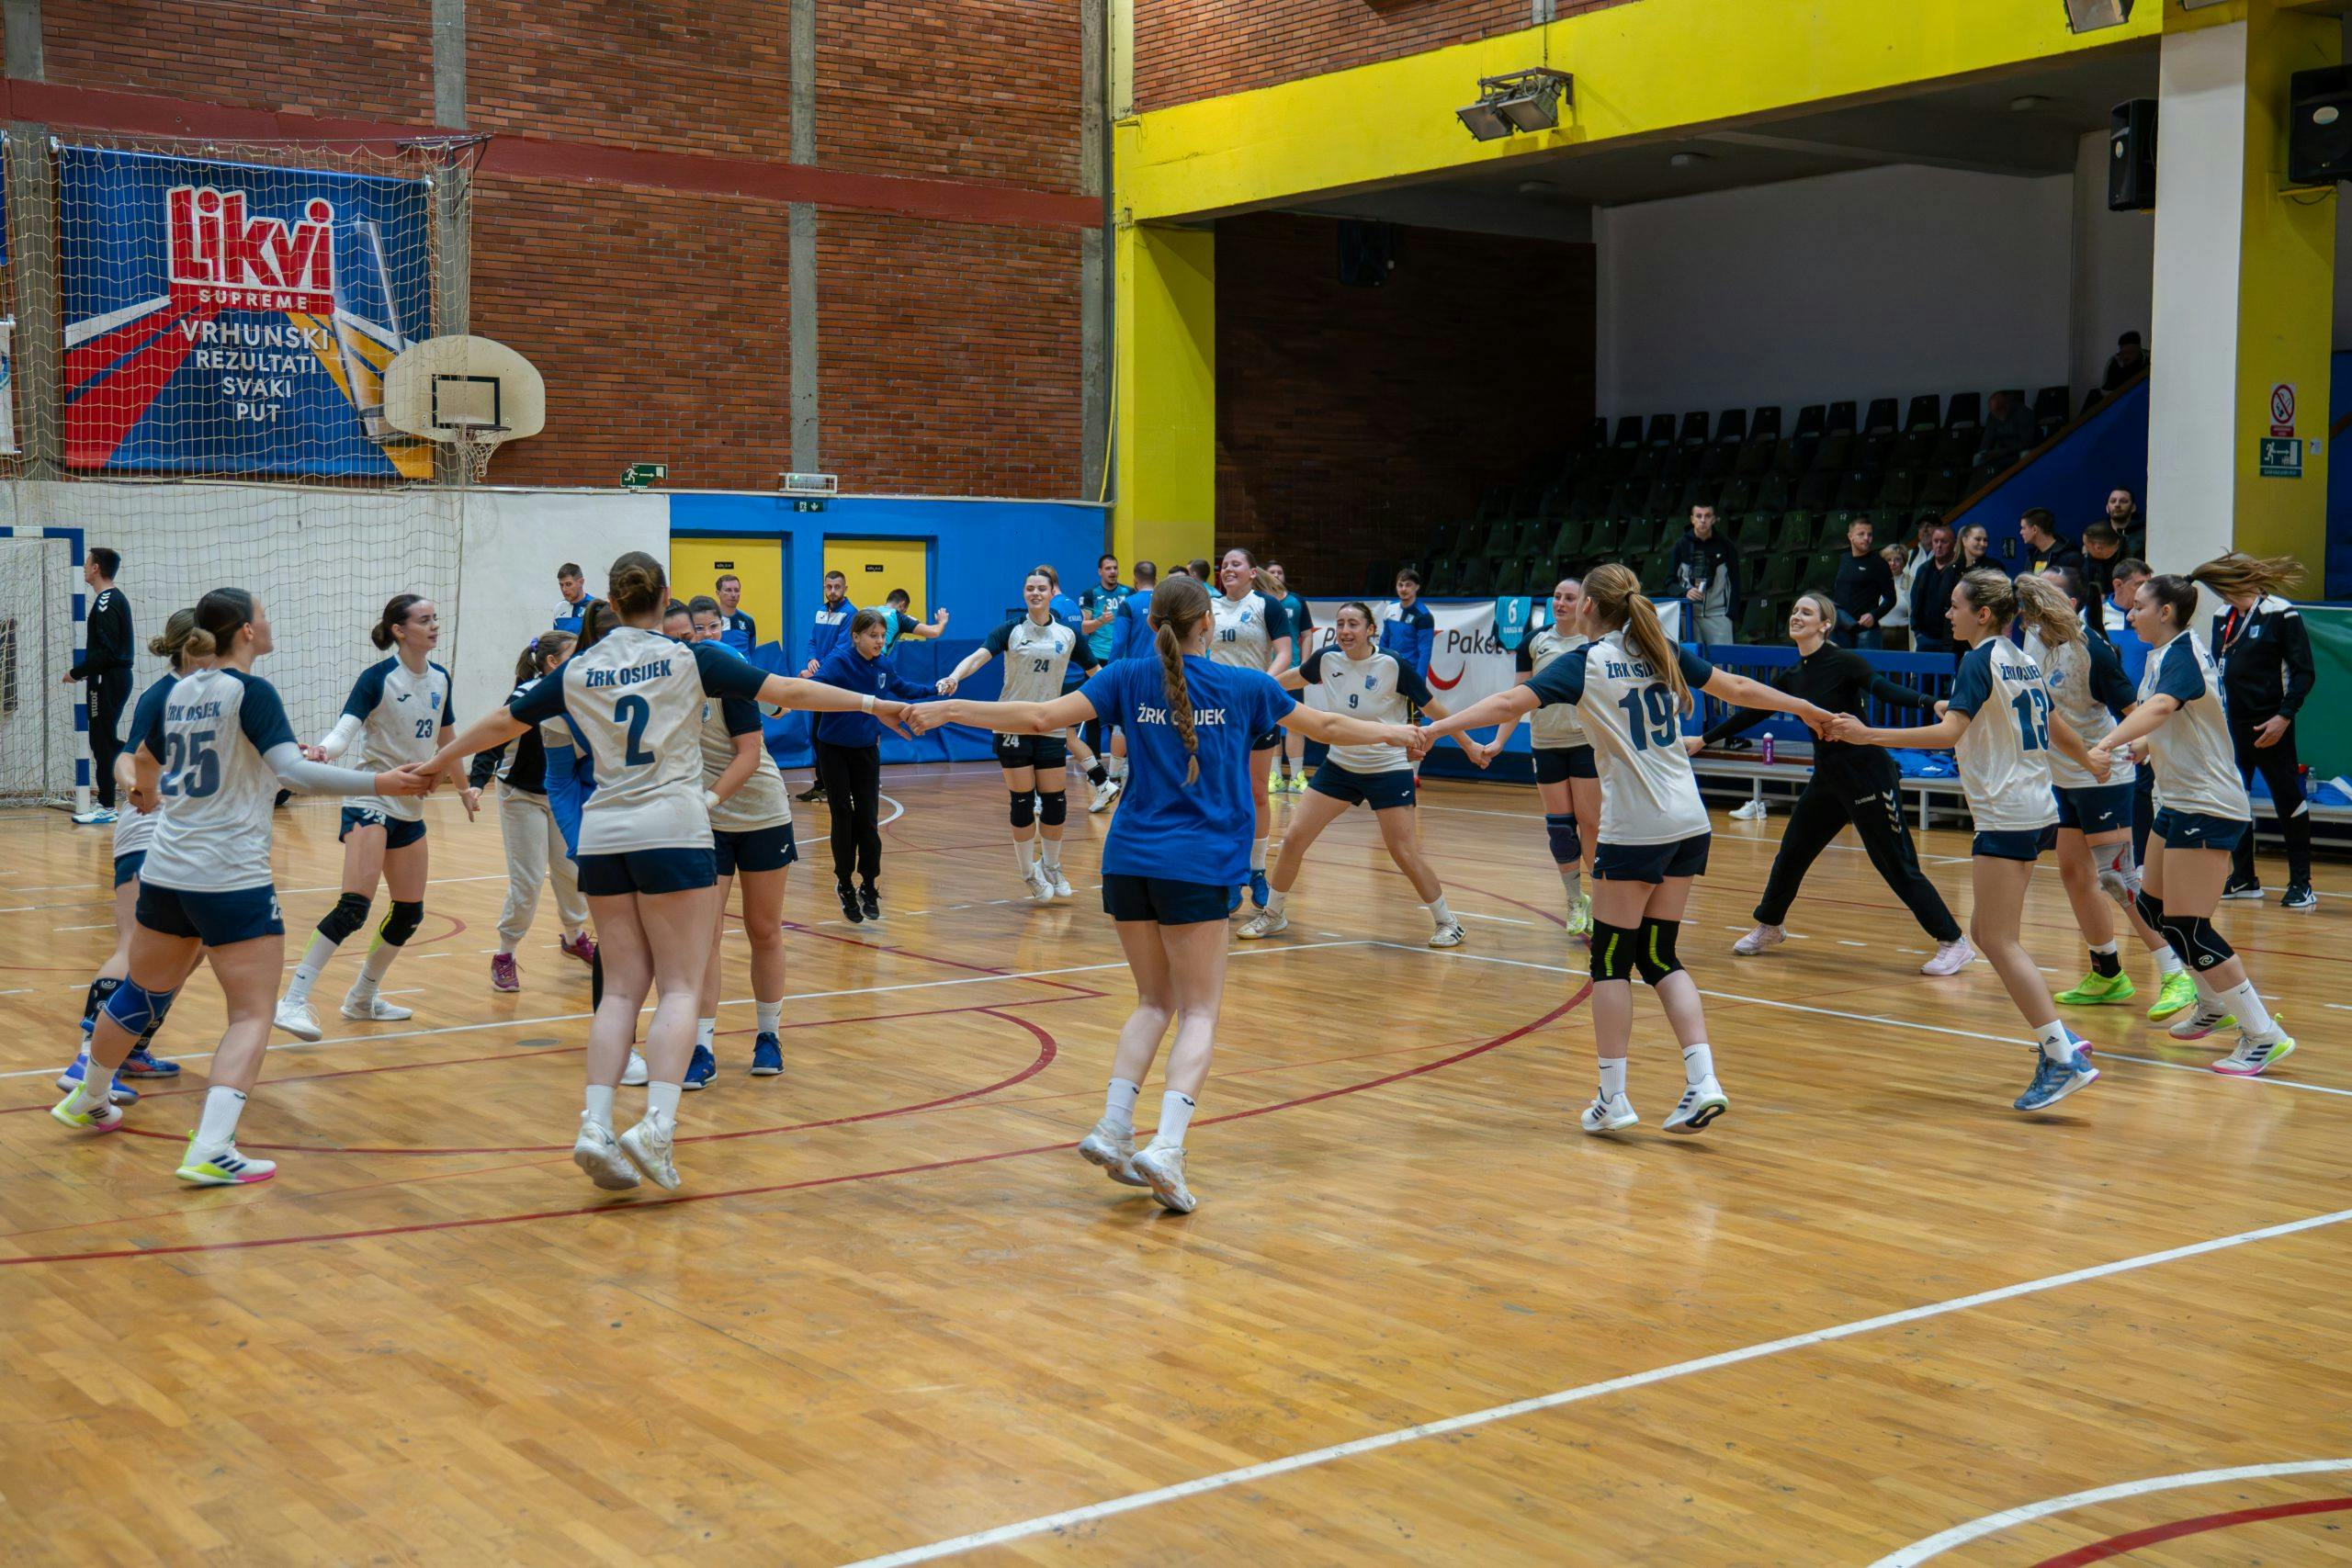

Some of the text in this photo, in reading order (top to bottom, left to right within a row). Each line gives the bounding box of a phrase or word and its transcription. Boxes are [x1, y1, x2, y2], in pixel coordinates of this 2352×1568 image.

[198, 288, 308, 310] SUPREME
[180, 319, 329, 351] VRHUNSKI
[196, 350, 316, 375] REZULTATI
[222, 376, 291, 398] SVAKI
[237, 402, 281, 423] PUT
[1106, 598, 1118, 610] 30
[1508, 599, 1519, 624] 6
[1220, 628, 1236, 642] 10
[586, 659, 673, 688] ŽRK OSIJEK
[1034, 659, 1050, 672] 24
[1605, 660, 1631, 679] ŽRK
[1349, 694, 1359, 709] 9
[1136, 702, 1227, 726] ŽRK IJEK
[1618, 682, 1677, 751] 19
[2011, 688, 2050, 751] 13
[415, 718, 435, 739] 23
[614, 694, 656, 767] 2
[1002, 733, 1021, 748] 24
[161, 729, 221, 798] 25
